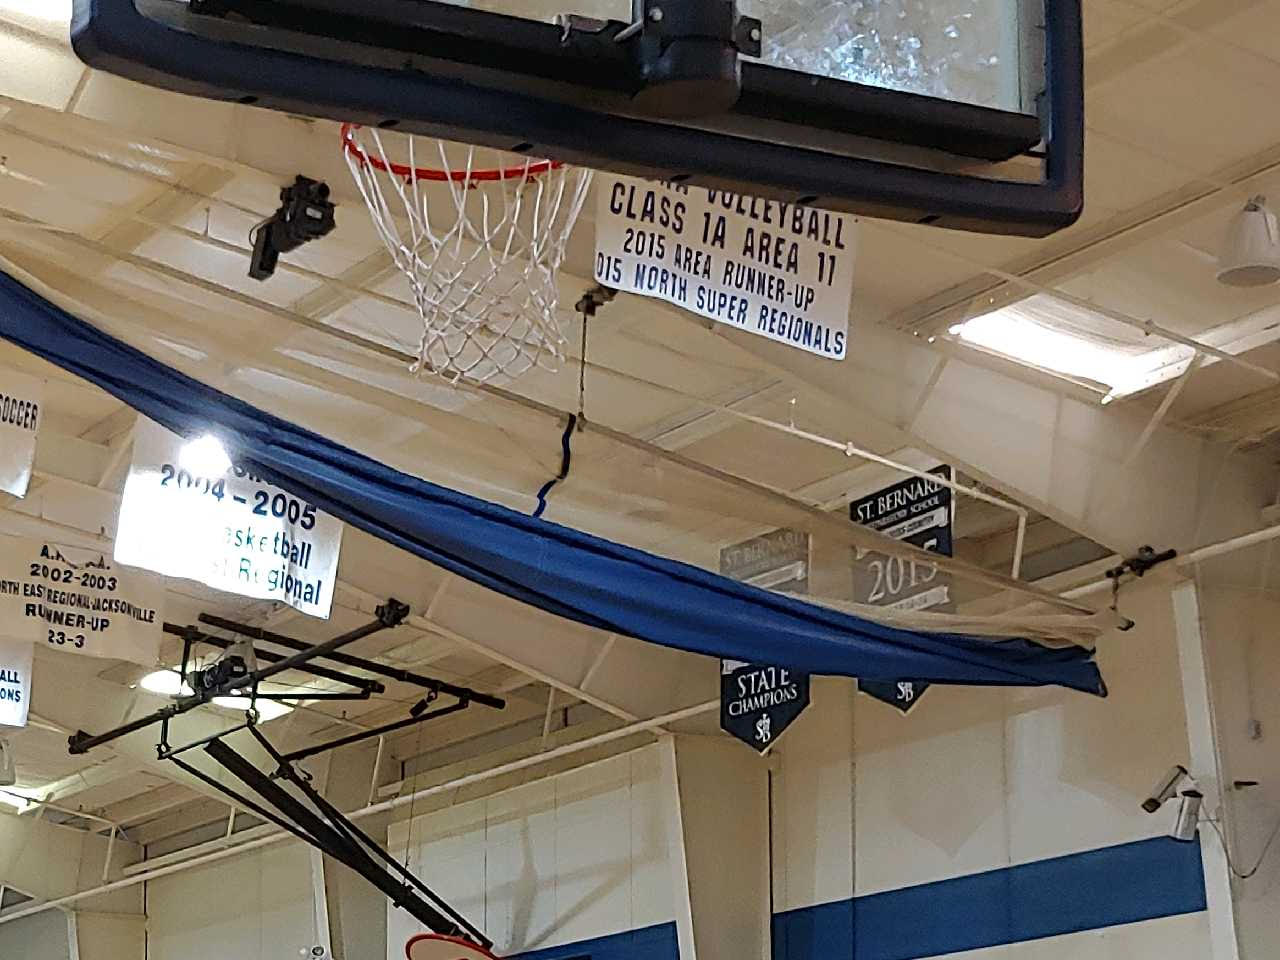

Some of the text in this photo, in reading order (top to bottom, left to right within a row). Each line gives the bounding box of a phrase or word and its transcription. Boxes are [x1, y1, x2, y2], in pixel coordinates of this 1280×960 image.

[610, 182, 685, 234] CLASS
[703, 212, 726, 249] 1A
[743, 228, 799, 274] AREA
[818, 252, 836, 286] 11
[624, 228, 815, 312] 2015 AREA RUNNER-UP
[635, 264, 687, 302] NORTH
[697, 286, 747, 324] SUPER
[758, 304, 844, 355] REGIONALS
[253, 490, 317, 530] 2005
[30, 563, 117, 591] 2002-2003
[25, 604, 110, 632] RUNNER-UP
[48, 629, 85, 648] 23-3
[738, 667, 790, 697] STATE
[729, 684, 797, 716] CHAMPIONS
